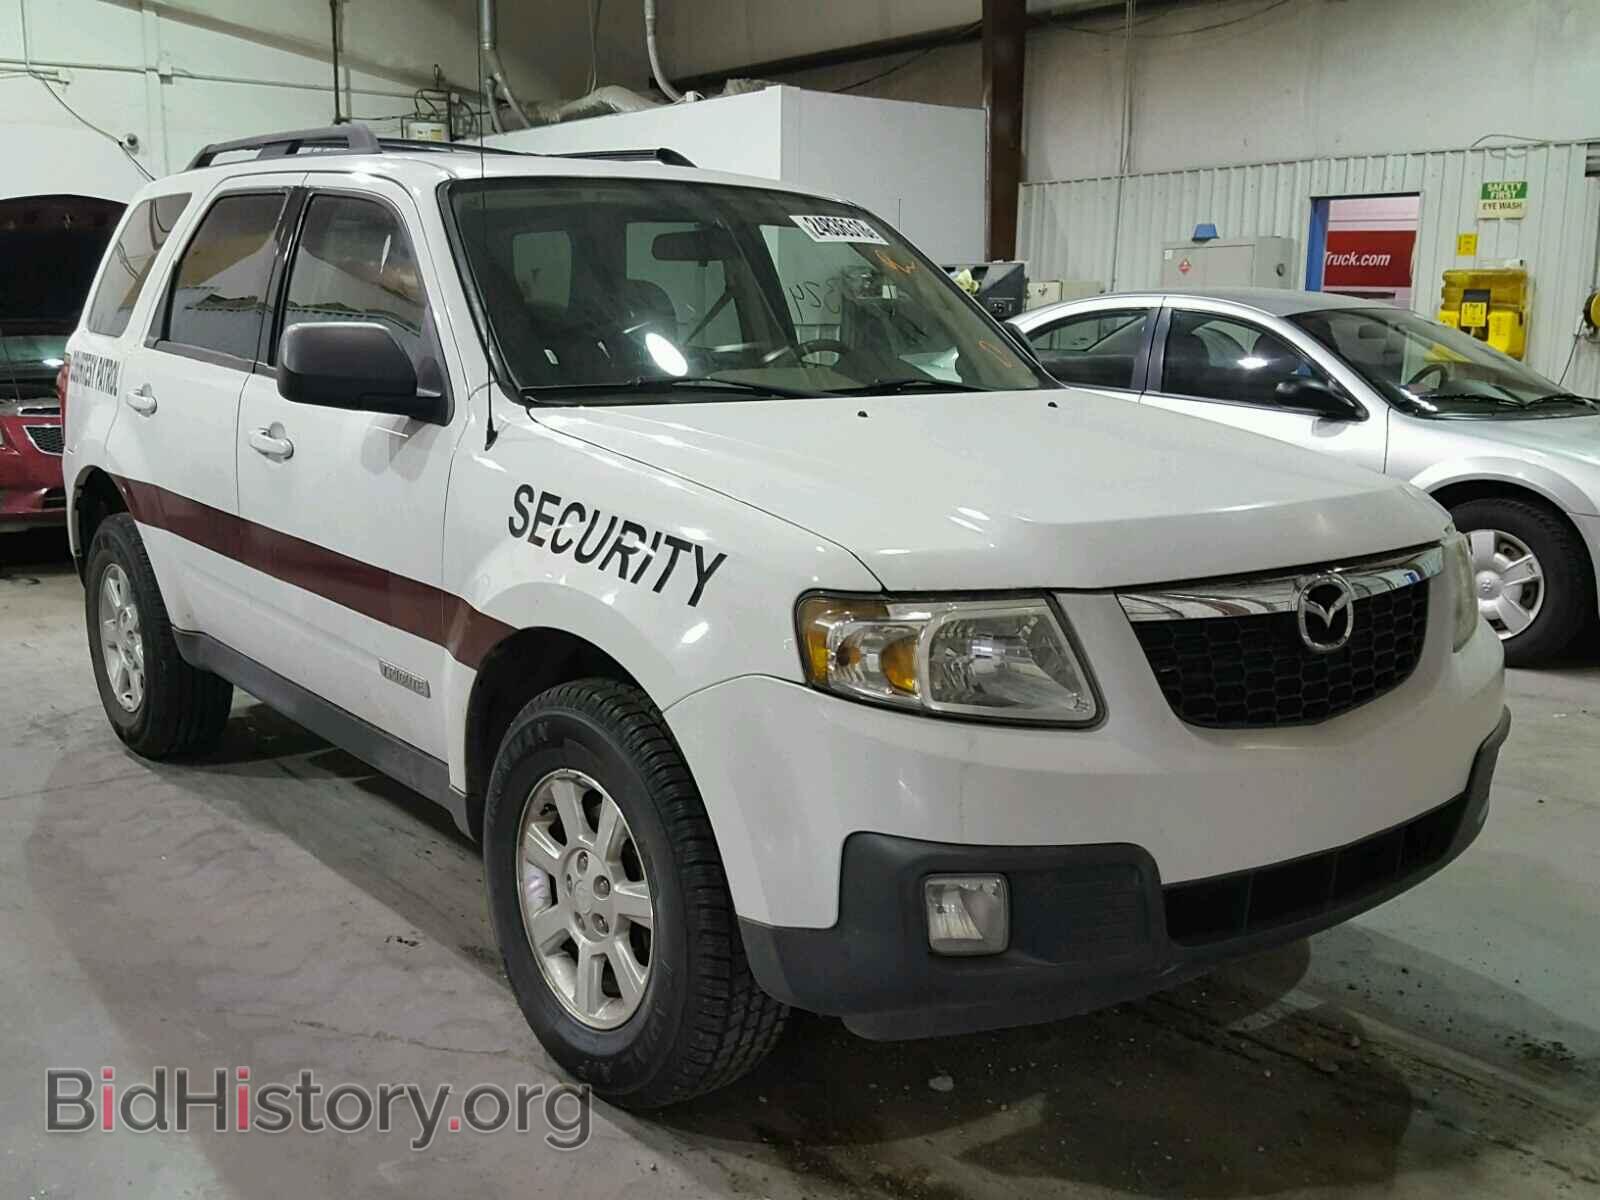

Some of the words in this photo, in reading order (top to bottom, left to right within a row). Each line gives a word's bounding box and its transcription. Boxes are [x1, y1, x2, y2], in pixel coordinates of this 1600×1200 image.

[1488, 183, 1521, 192] SAFETY
[1490, 191, 1517, 200] FIRST
[1482, 202, 1497, 210] EYE
[1499, 201, 1522, 209] WASH
[508, 483, 728, 607] SECURITY
